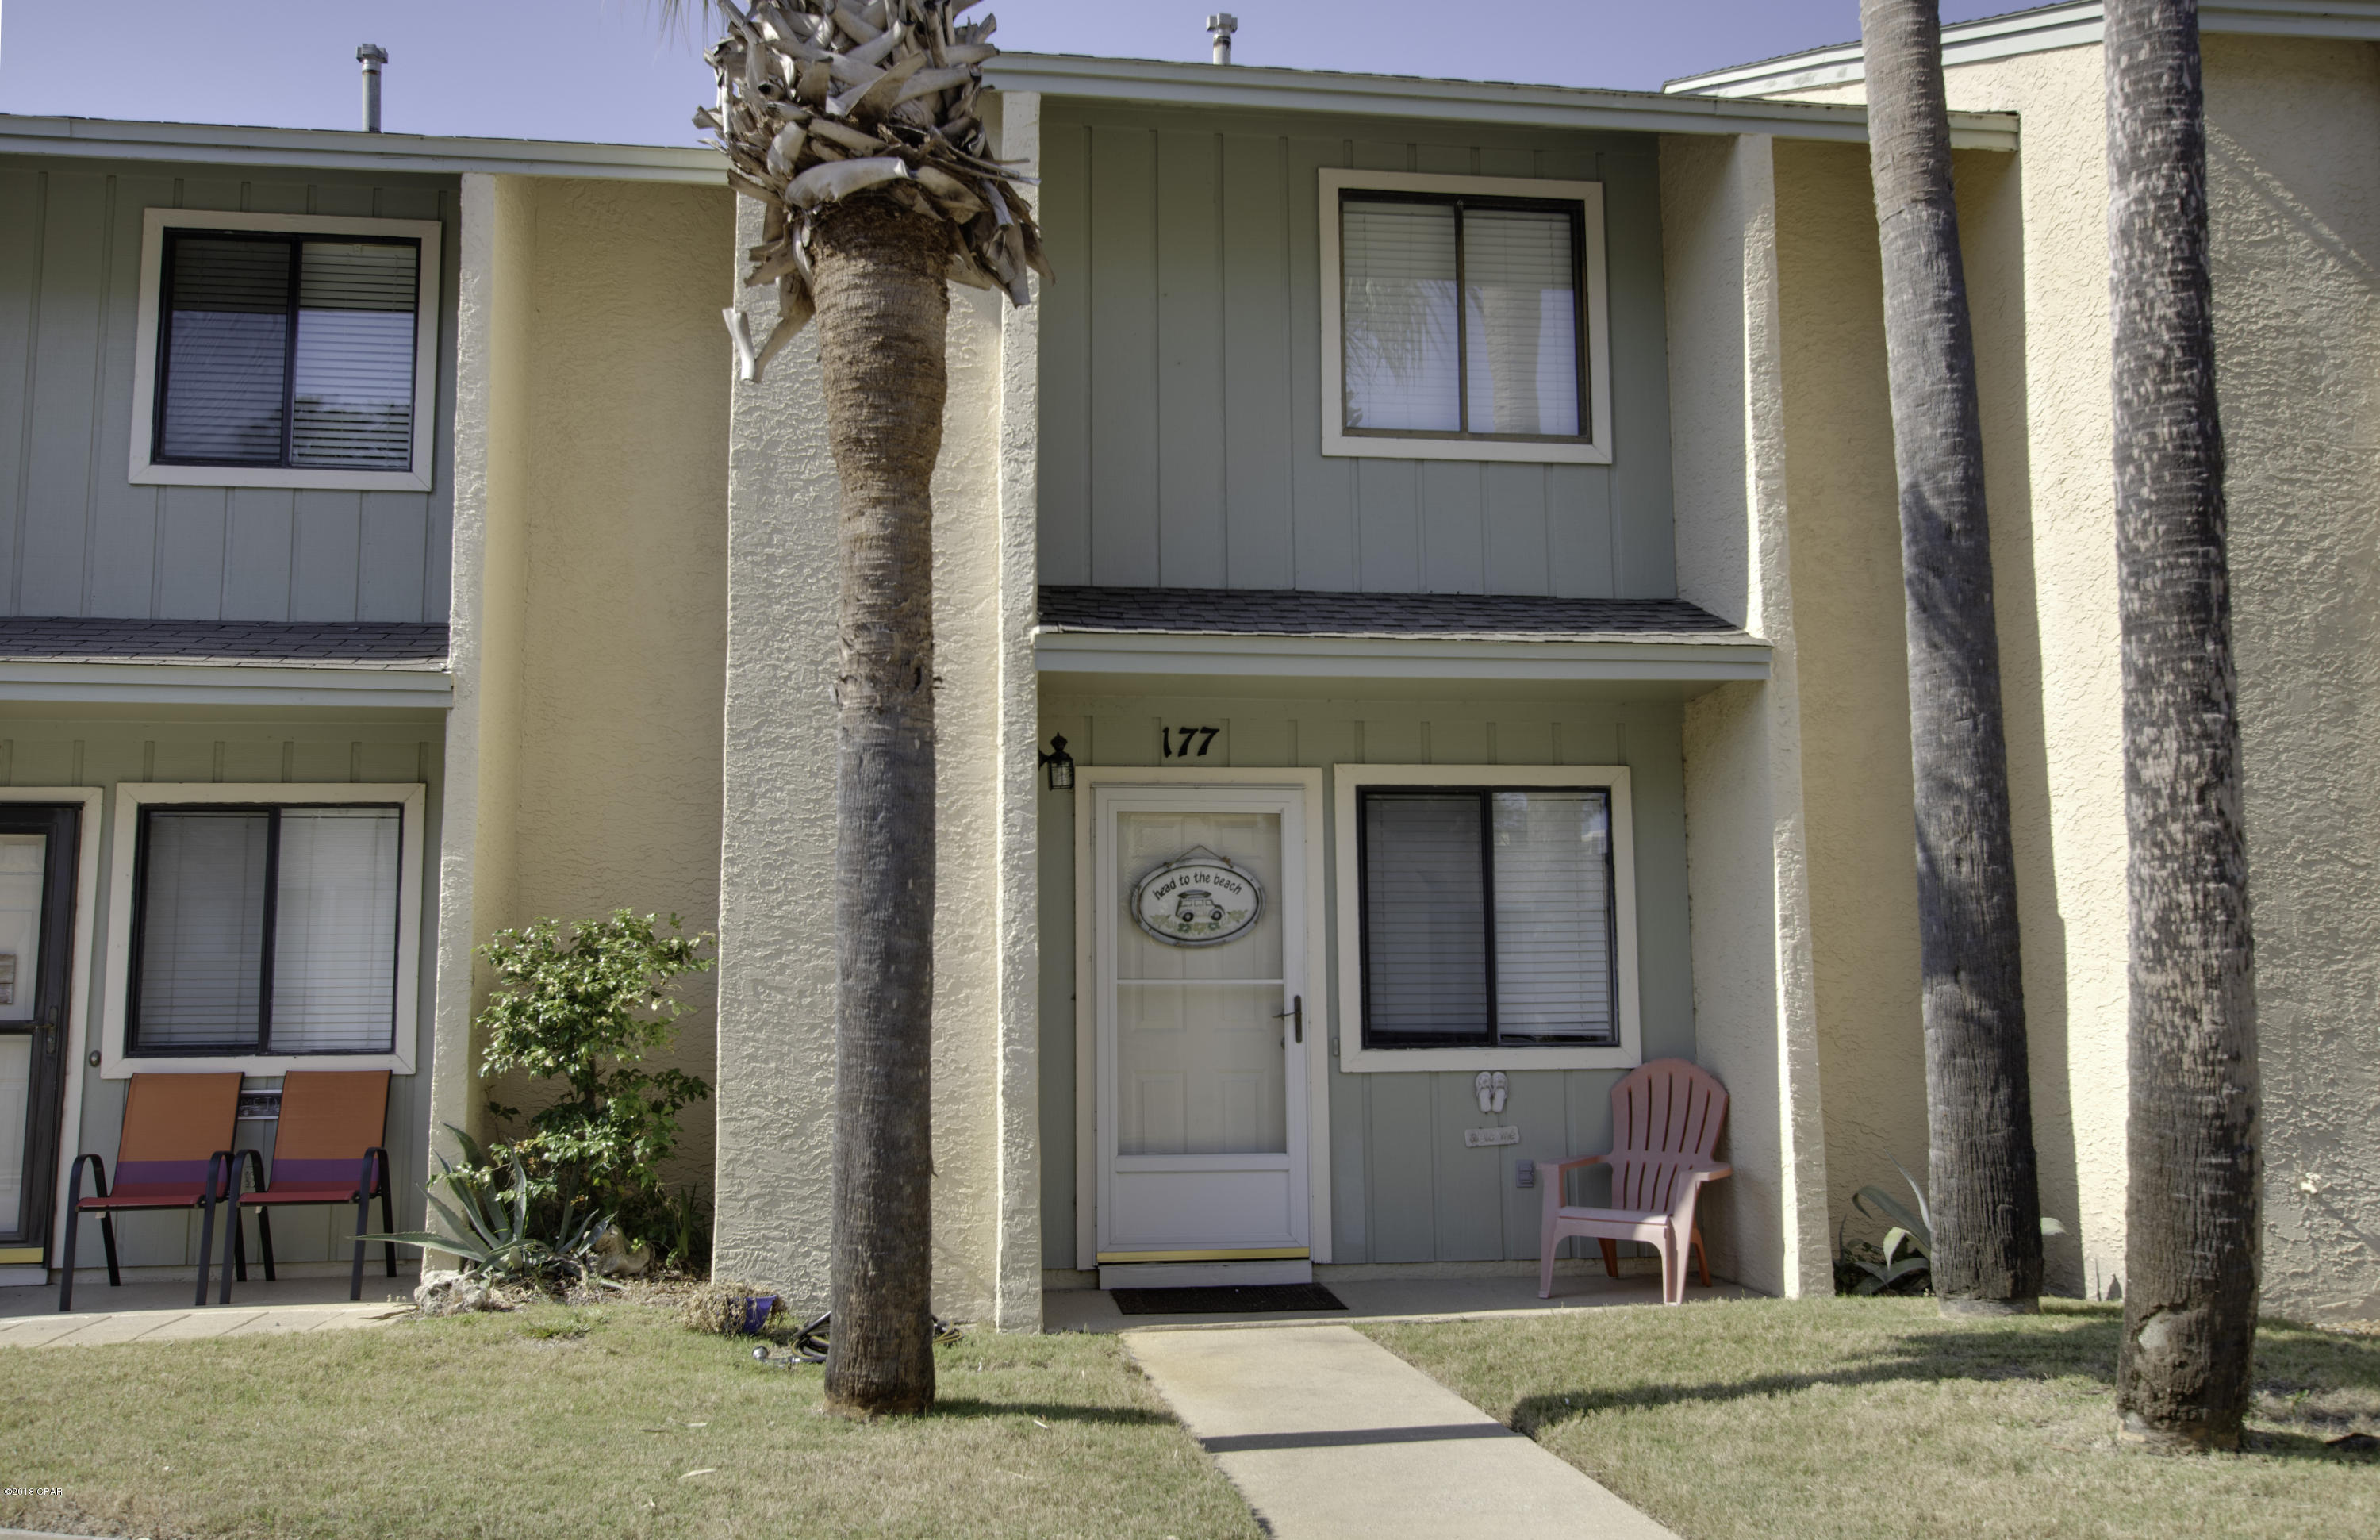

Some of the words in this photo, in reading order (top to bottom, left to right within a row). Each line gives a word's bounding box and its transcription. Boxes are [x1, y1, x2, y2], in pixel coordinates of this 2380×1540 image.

[1162, 726, 1220, 758] 177
[1153, 878, 1177, 900] head
[1179, 874, 1190, 885] to
[1194, 872, 1211, 884] the
[1214, 874, 1242, 895] beach
